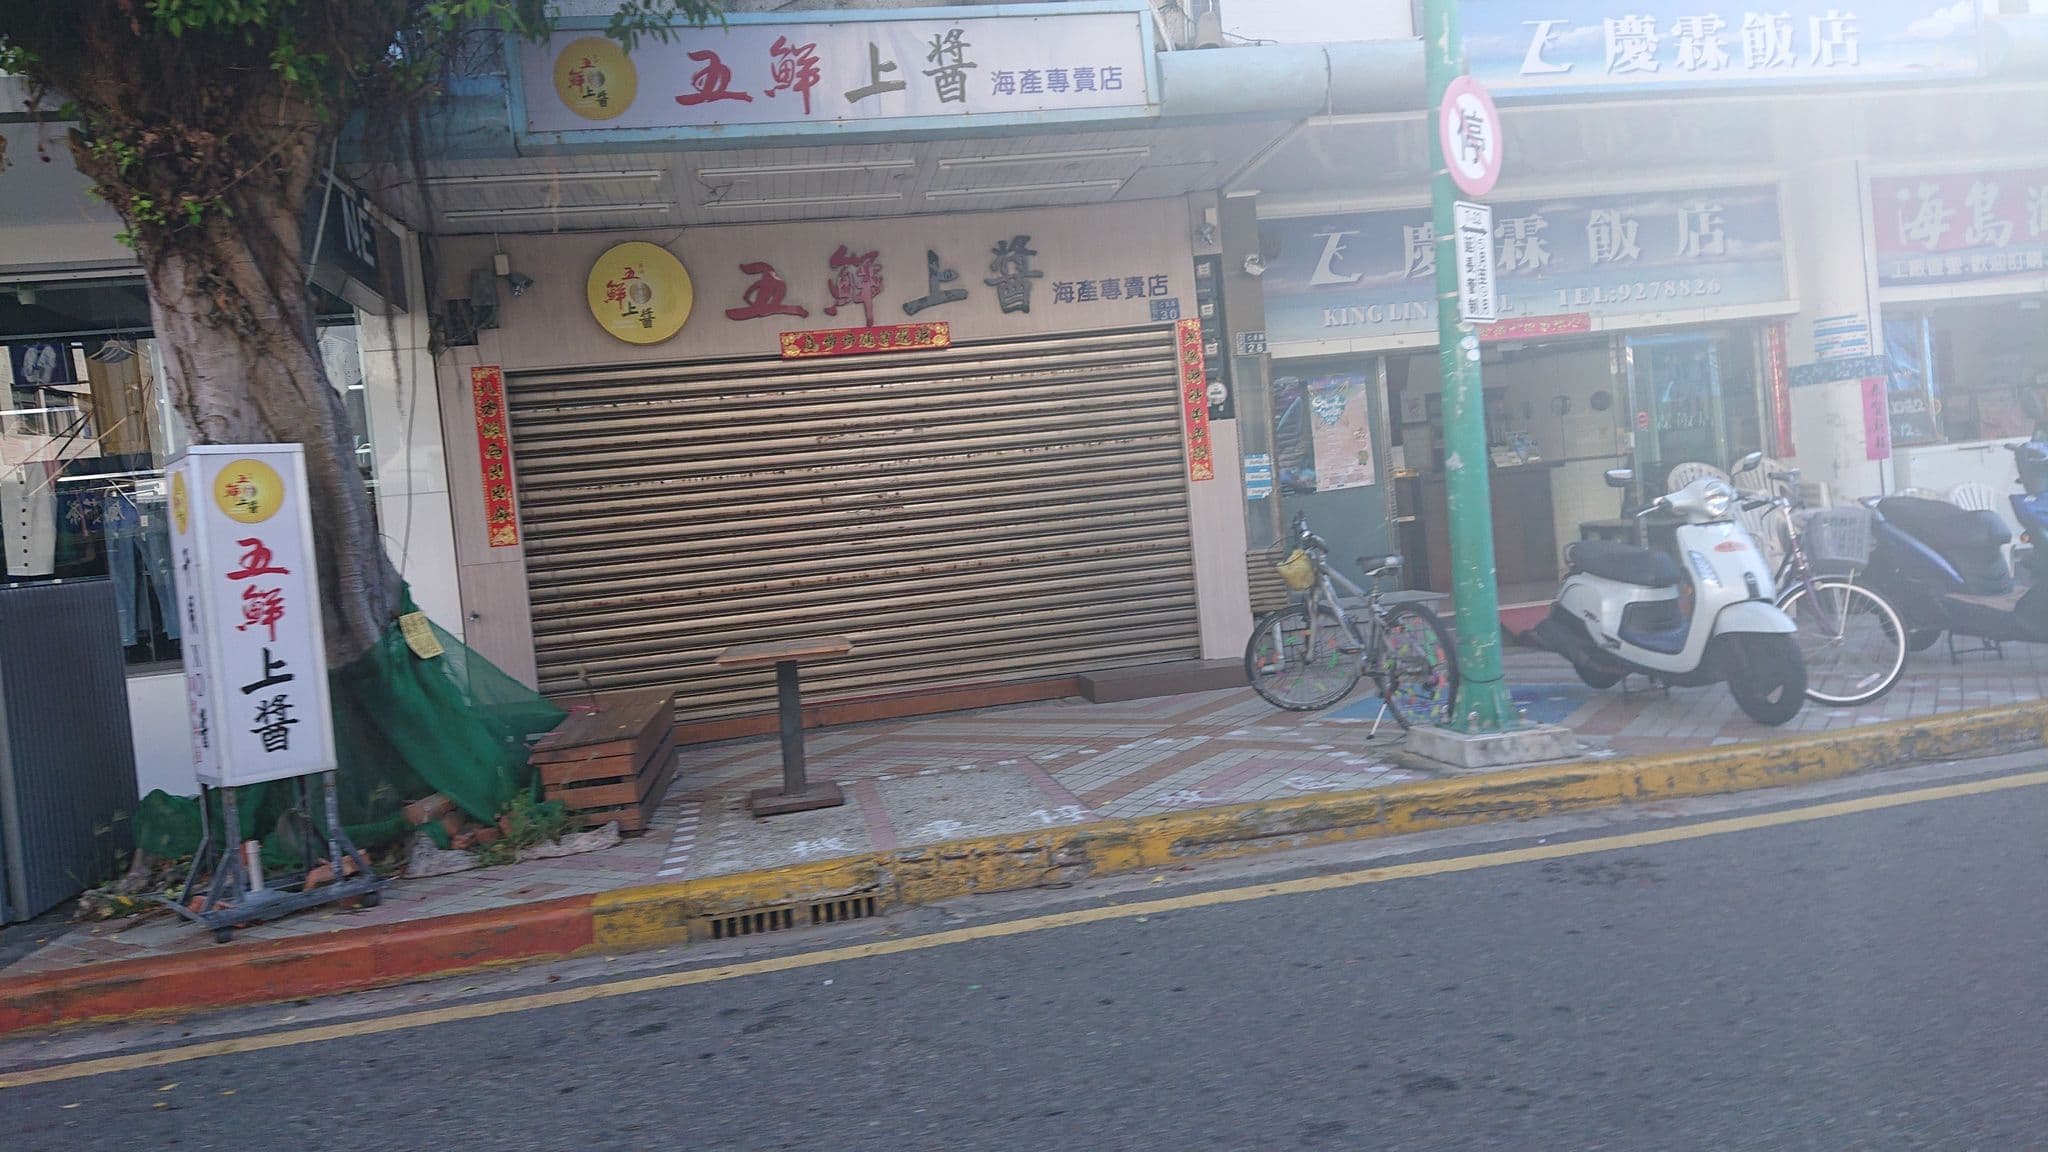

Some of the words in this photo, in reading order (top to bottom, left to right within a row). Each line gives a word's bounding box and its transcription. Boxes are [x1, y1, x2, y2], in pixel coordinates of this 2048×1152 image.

[675, 29, 978, 115] 五鮮上醬
[1603, 9, 1862, 74] 慶霖飯店
[990, 65, 1123, 98] 海產專賣店
[1456, 107, 1487, 164] 停
[725, 235, 1044, 327] 五鮮上醬
[1052, 274, 1169, 304] 海產專賣店
[1322, 304, 1383, 328] KING
[1389, 300, 1428, 322] LIN
[225, 537, 301, 754] 五鮮上醬
